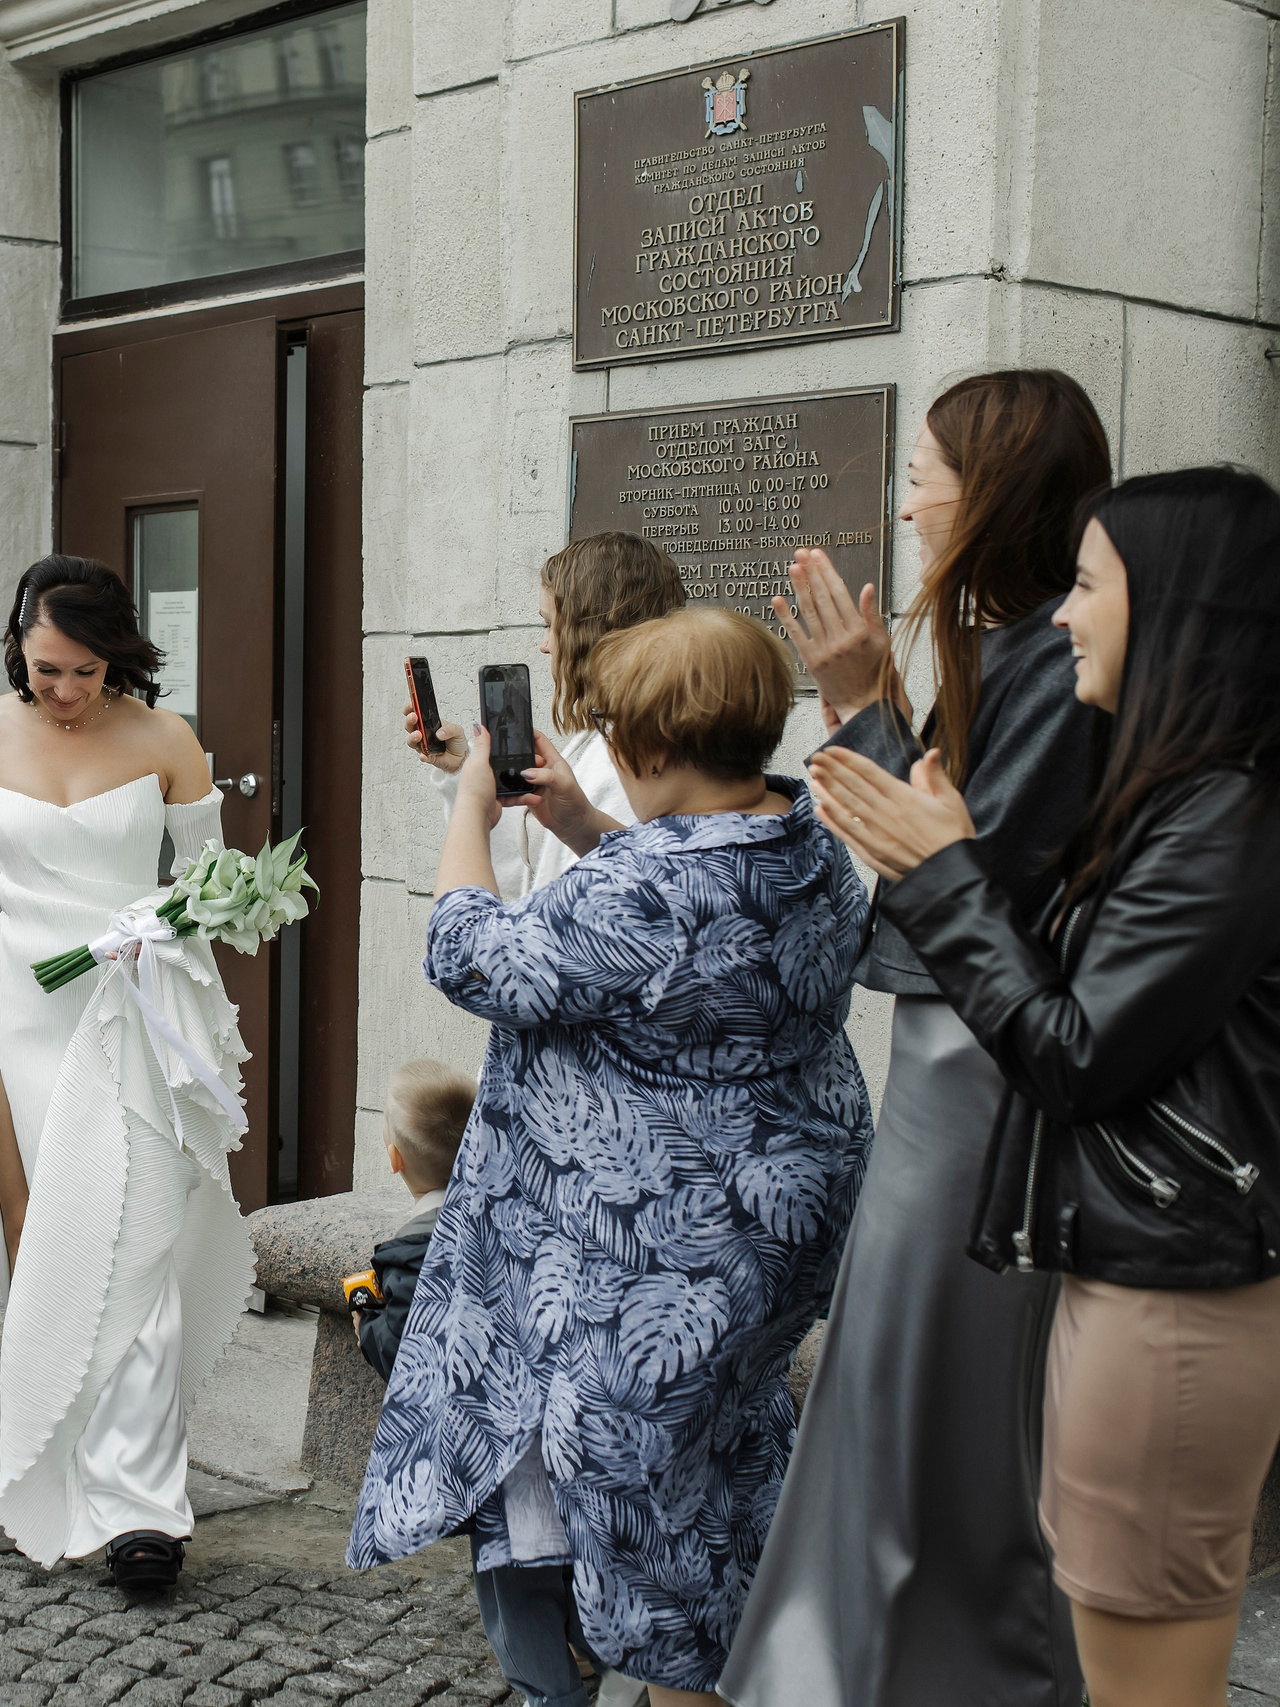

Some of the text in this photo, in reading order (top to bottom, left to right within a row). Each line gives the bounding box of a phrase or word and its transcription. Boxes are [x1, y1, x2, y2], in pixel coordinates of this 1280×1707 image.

[634, 123, 827, 169] ПРАВИТЕЛЬСТВО САНКТ-ПЕТЕРБУРГА
[634, 139, 826, 185] КОМИТЕТ ПО ДЕЛАМ ЗАПИСИ АКТОВ
[653, 157, 806, 194] ГРАЖДАНСКОГО СОСТОЯНИЯ
[689, 184, 763, 215] ОТДЕЛ
[640, 200, 814, 248] ЗАПИСИ АКТОВ
[635, 225, 820, 274] ГРАЖДАНСКОГО
[658, 255, 794, 293] СОСТОЯНИЯ
[601, 286, 759, 327] МОСКОВСКОГО
[615, 300, 840, 348] САНКТ-ПЕТЕРБУРГА
[648, 413, 798, 442] ПРИЕМ ГРАЖДАН
[656, 434, 787, 460] ОТДЕЛОМ ЗАГС
[627, 450, 820, 480] МОСКОВСКОГО РАЙОНА
[619, 481, 741, 503] ВТОРНИК-ПЯТНИЦА
[643, 504, 699, 519] СУББОТА
[641, 522, 699, 538] ПЕРЕРЫВ
[836, 531, 872, 547] ДЕНЬ
